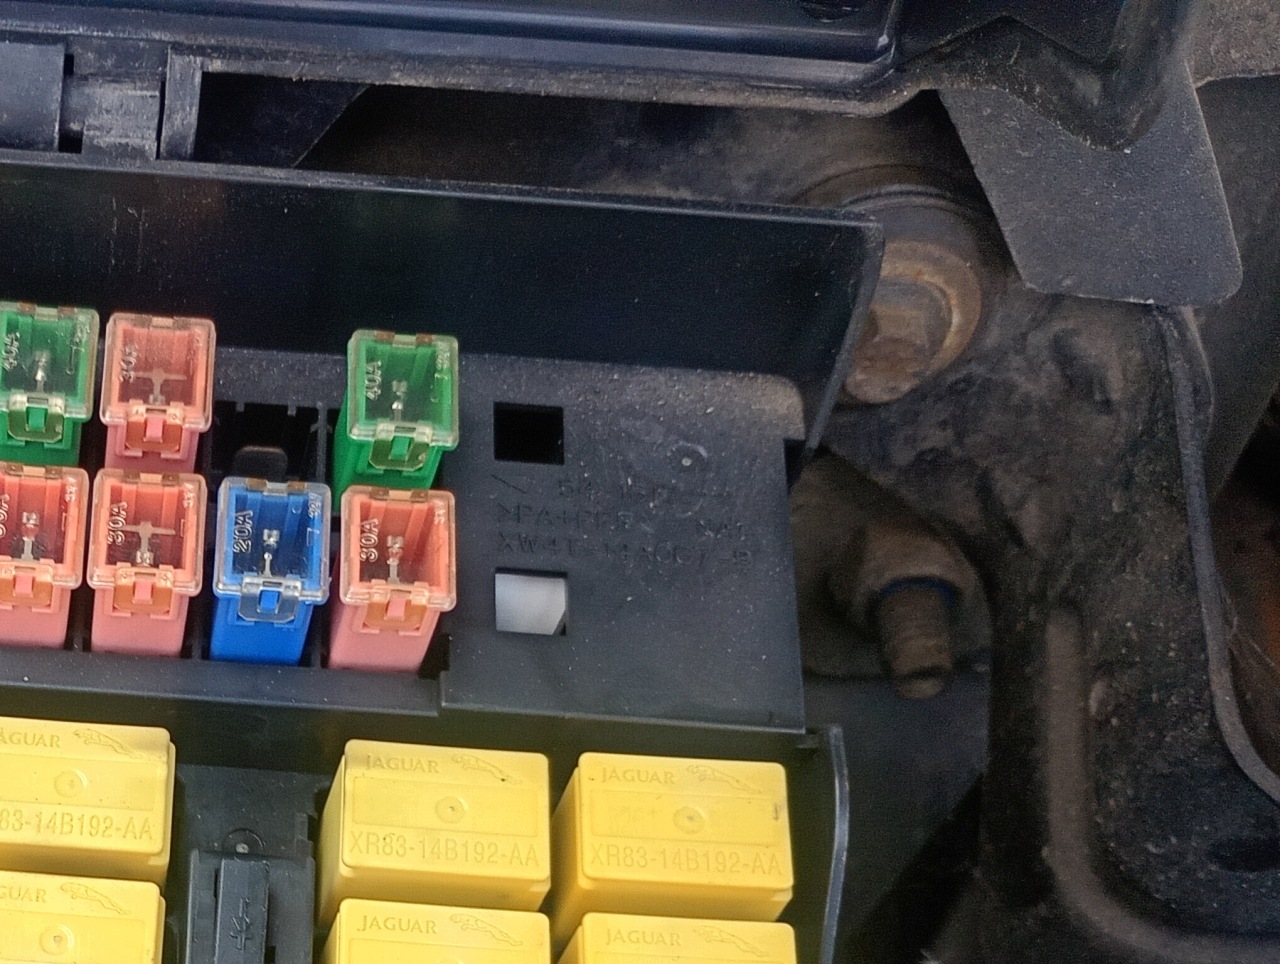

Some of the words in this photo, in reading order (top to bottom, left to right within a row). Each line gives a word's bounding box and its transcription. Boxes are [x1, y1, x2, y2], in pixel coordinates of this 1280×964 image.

[365, 359, 383, 402] 40A
[105, 501, 128, 545] 30A
[232, 509, 254, 555] 20A
[358, 517, 380, 563] 30A
[366, 754, 440, 774] JAGUAR
[600, 766, 676, 786] JAGUAR
[349, 830, 541, 868] XR83-14B192-AA
[590, 842, 784, 876] XR83-14B192-AA
[358, 914, 438, 935] JAGUAR
[605, 928, 682, 947] JAGUAR
